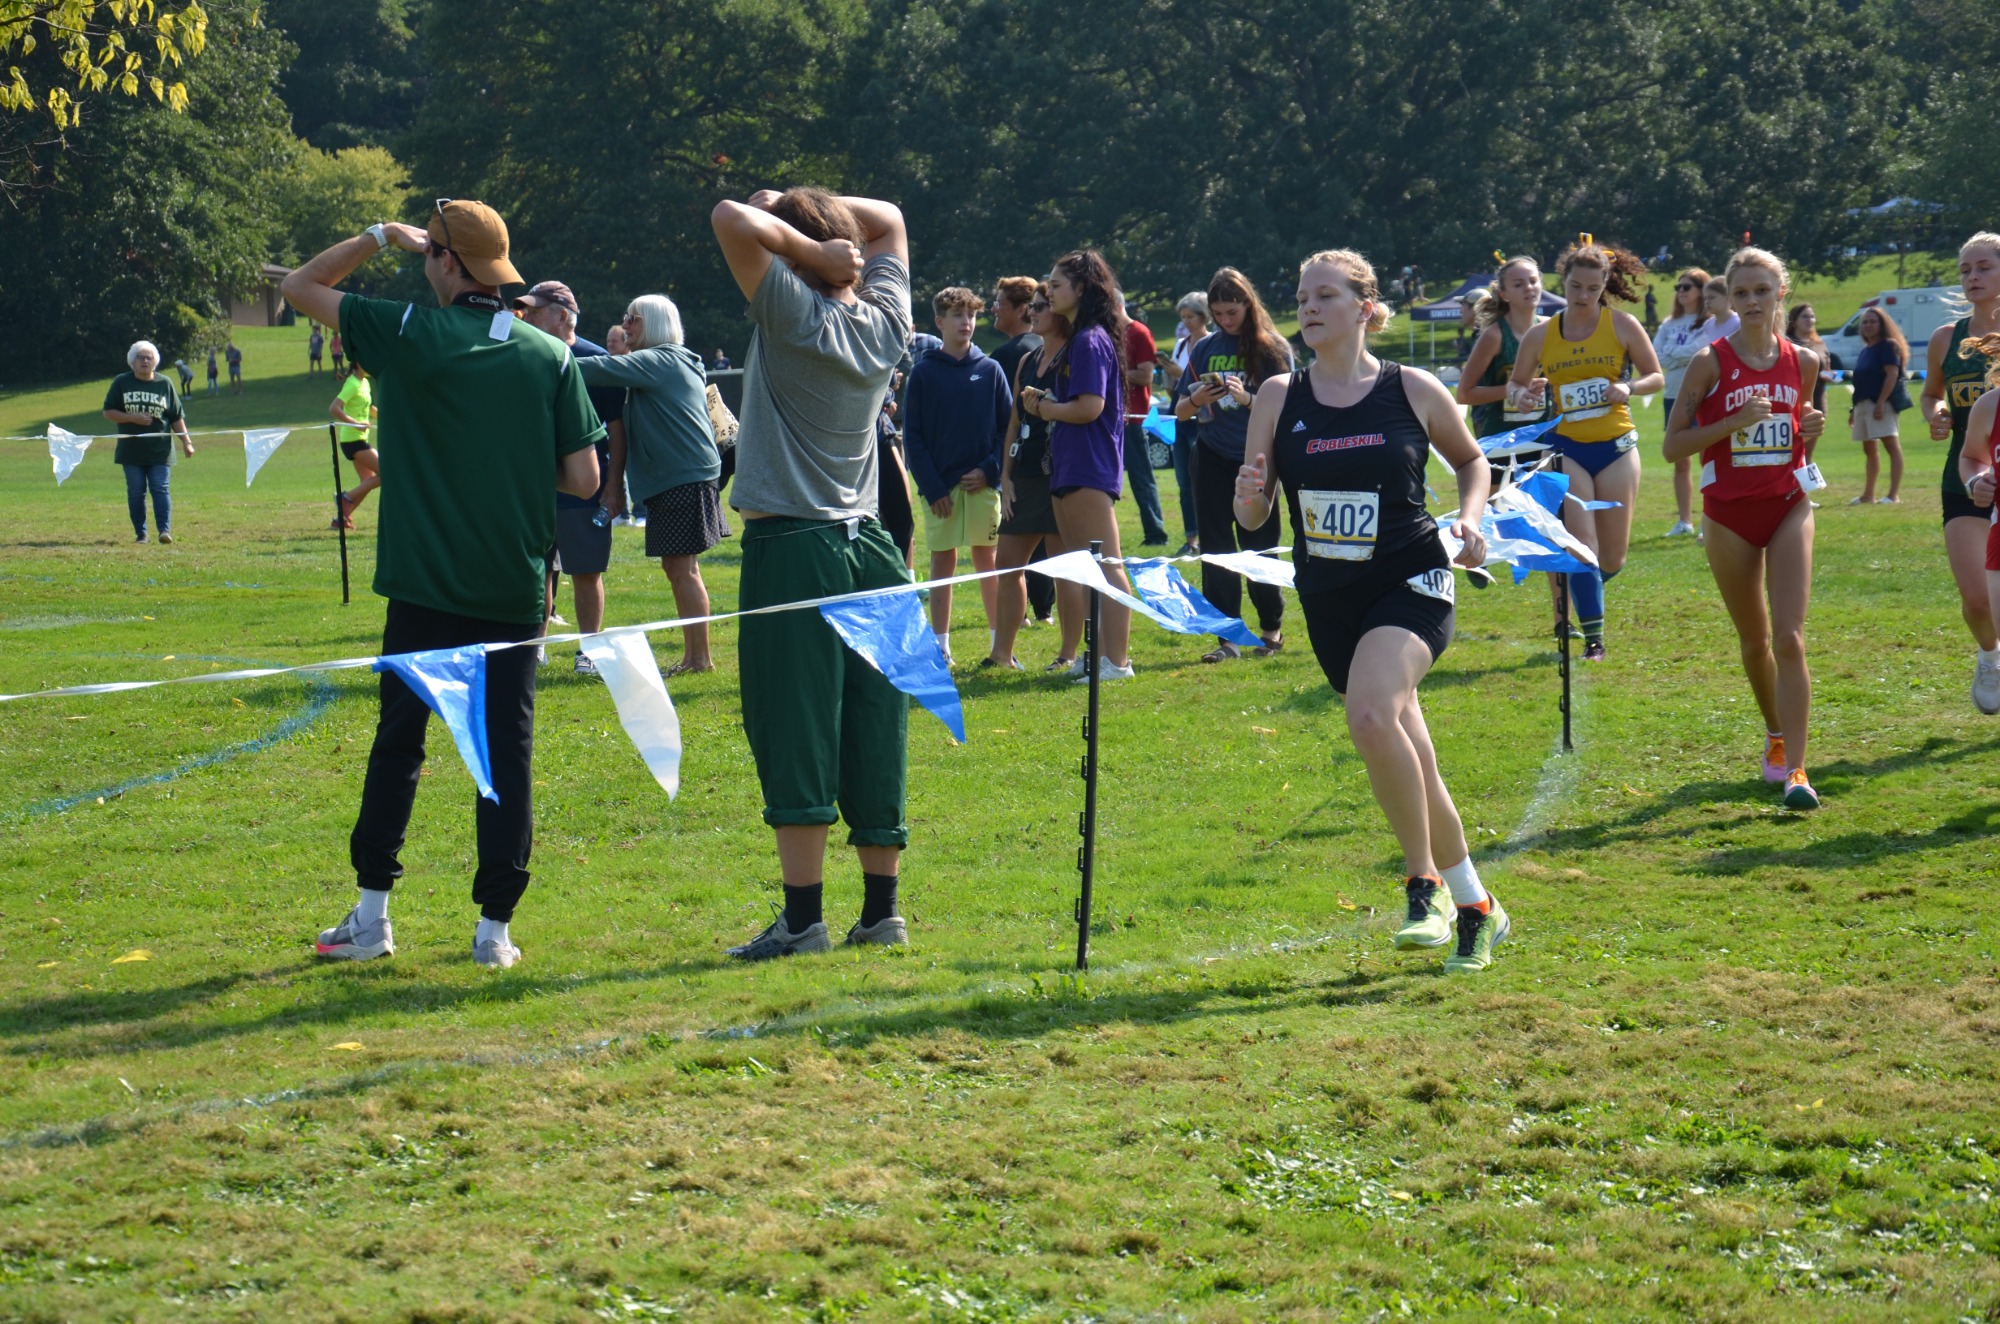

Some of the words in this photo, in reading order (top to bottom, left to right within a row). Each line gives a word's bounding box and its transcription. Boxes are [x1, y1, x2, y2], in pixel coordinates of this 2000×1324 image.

[469, 295, 499, 307] Canon
[1548, 360, 1581, 374] ALFRED
[1585, 356, 1616, 367] STATE
[123, 391, 167, 410] KEUKA
[1753, 422, 1790, 448] 419
[1322, 503, 1375, 538] 402
[1422, 570, 1452, 598] 402
